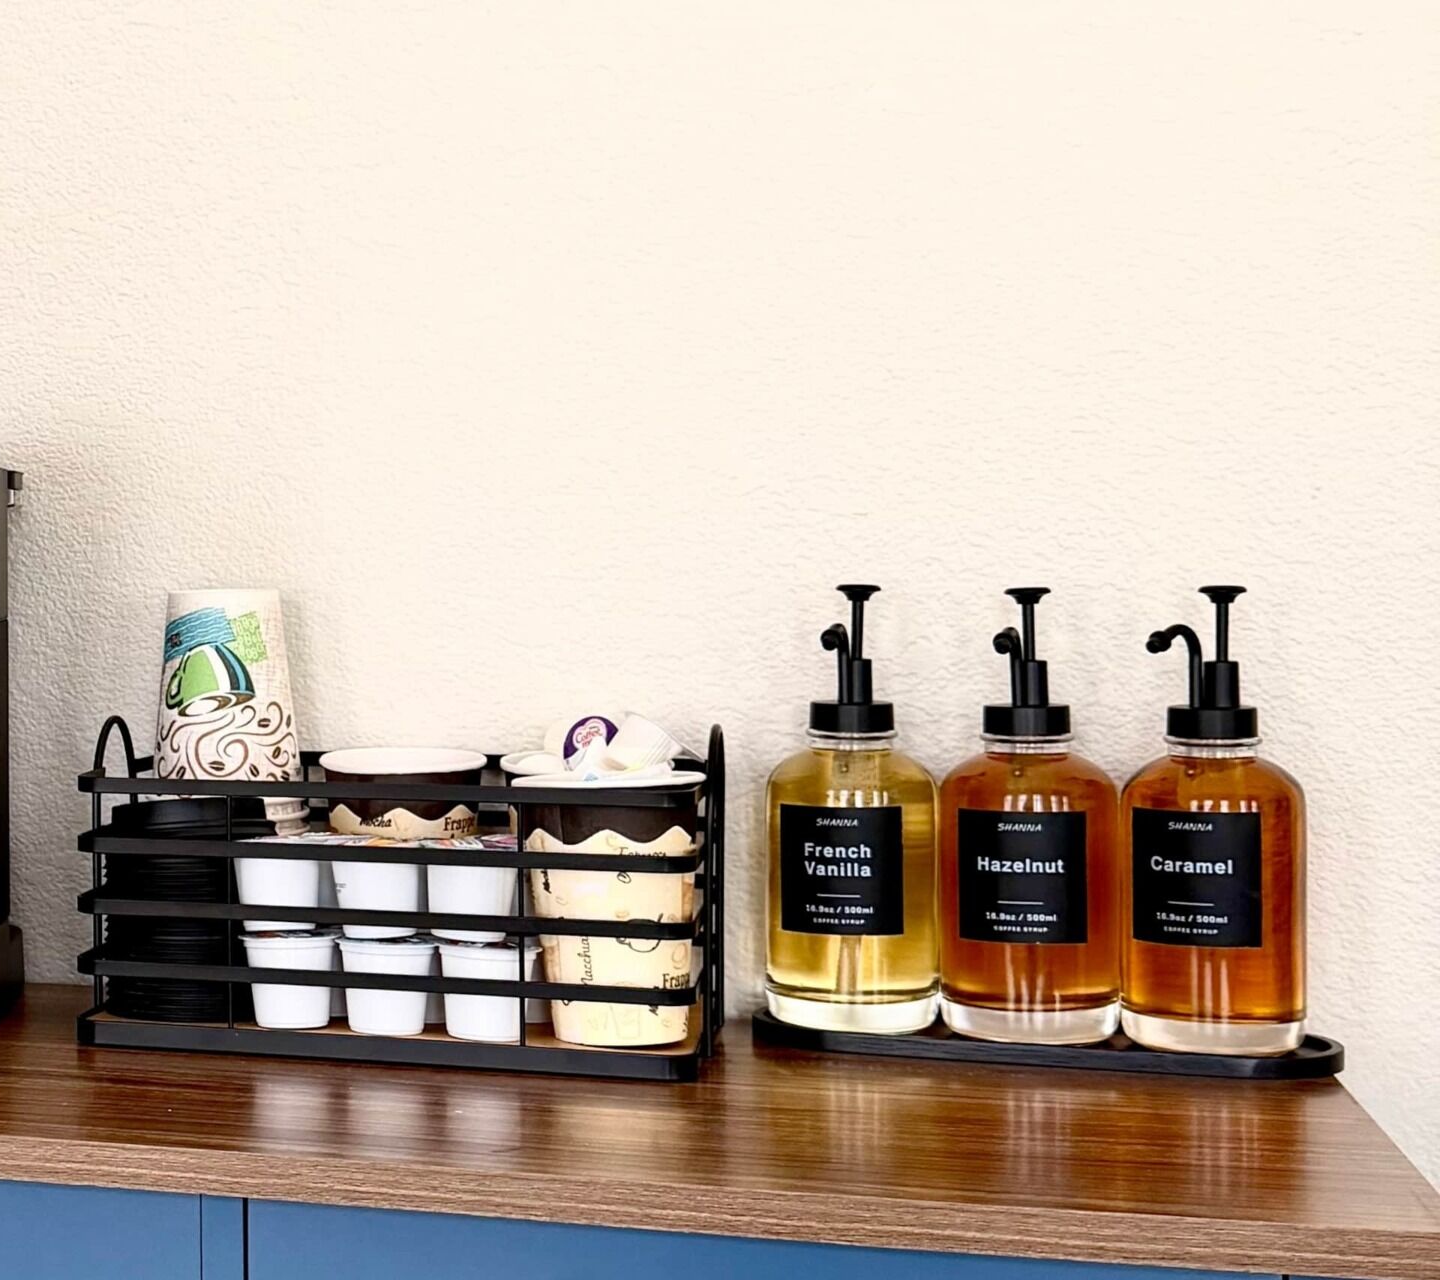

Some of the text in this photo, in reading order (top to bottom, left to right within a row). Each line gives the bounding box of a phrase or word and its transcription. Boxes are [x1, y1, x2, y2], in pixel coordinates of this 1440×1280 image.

[815, 818, 859, 827] SHANNA
[1168, 822, 1213, 831] SHANNA
[997, 823, 1042, 832] SHANNA
[804, 842, 872, 858] French
[804, 861, 872, 877] Vanilla
[977, 856, 1064, 873] Hazelnut
[1150, 855, 1233, 874] Caramel
[844, 906, 874, 914] 500ml
[1026, 913, 1057, 922] 500ml
[1196, 914, 1228, 923] 500ml
